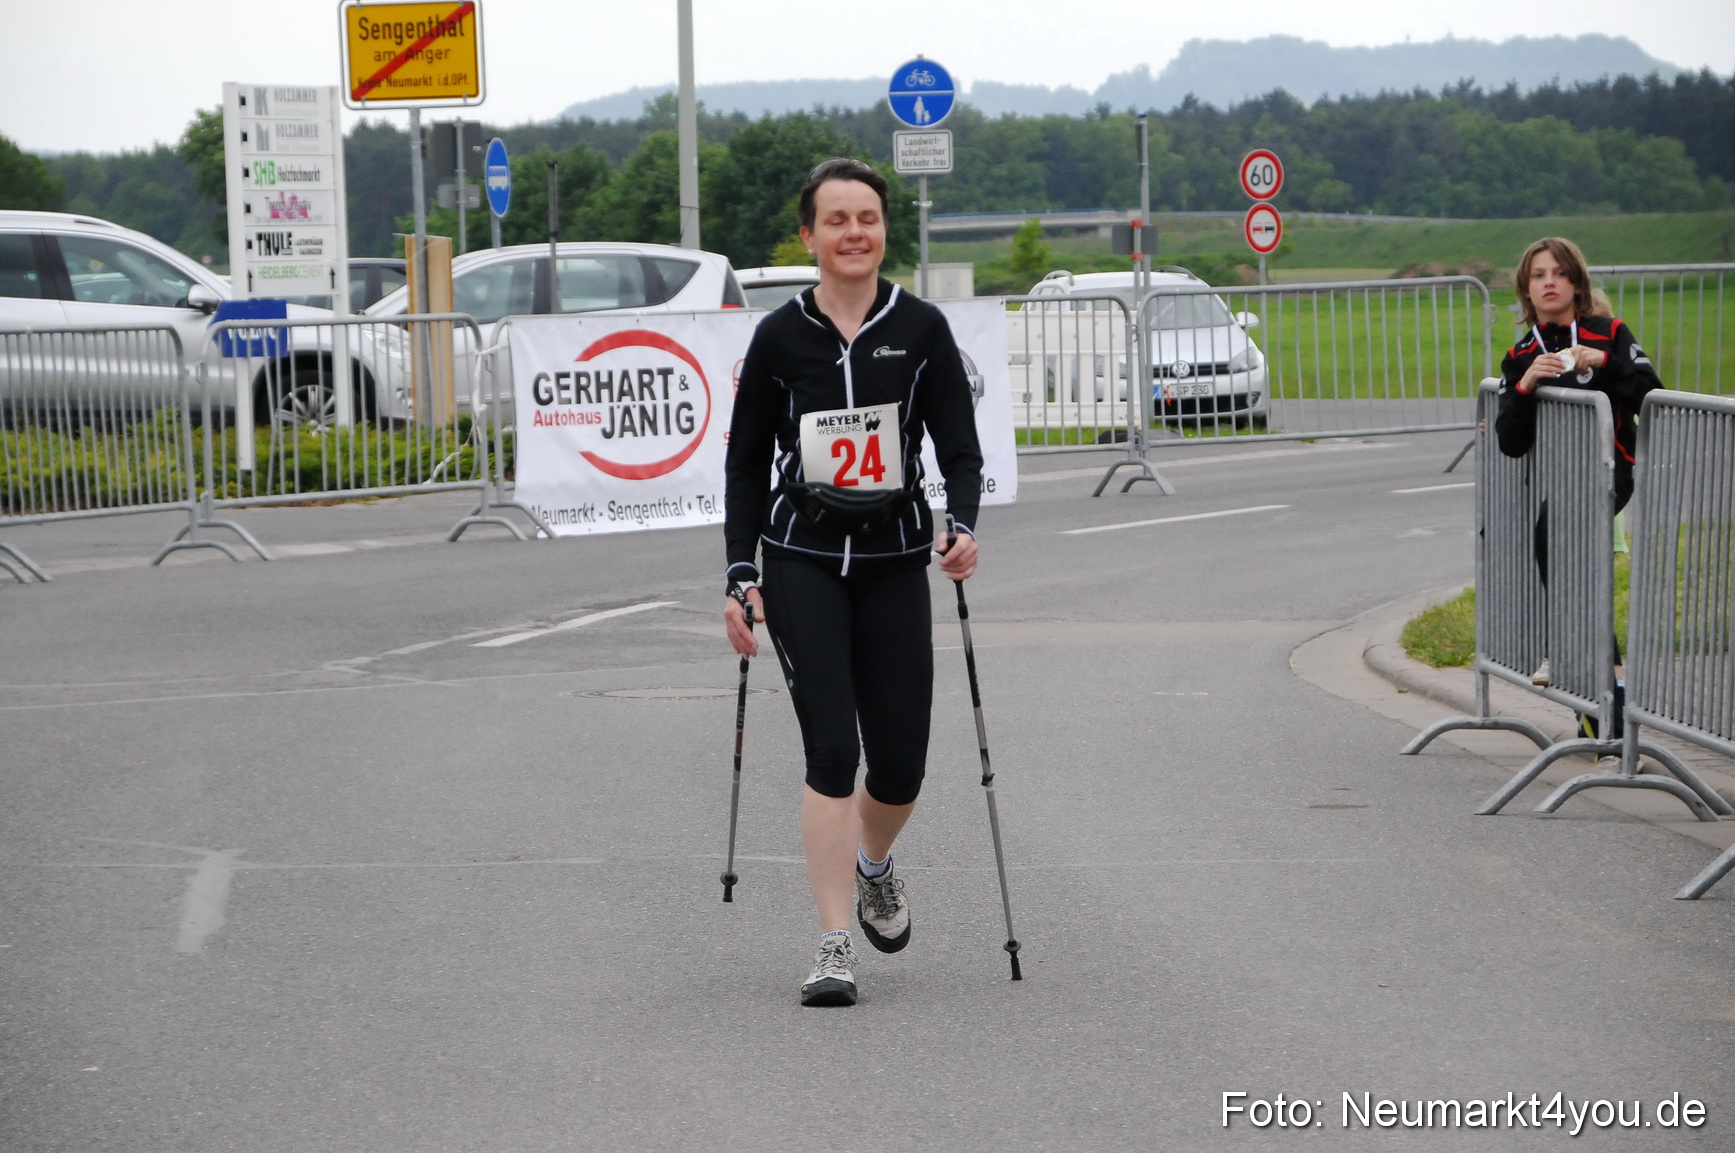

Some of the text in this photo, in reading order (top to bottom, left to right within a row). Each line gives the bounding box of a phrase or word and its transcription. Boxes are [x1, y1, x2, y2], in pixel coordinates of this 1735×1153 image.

[358, 14, 465, 46] Sengenthal
[374, 47, 451, 63] am Anger
[358, 76, 381, 88] Kreis
[386, 75, 432, 88] Neumarkt
[904, 136, 942, 146] Landwirt-
[901, 146, 946, 156] schaftlicher
[901, 158, 947, 167] Verkehr frei
[1250, 164, 1273, 186] 60
[255, 231, 293, 256] THULE
[532, 367, 690, 406] GERHART &
[533, 408, 602, 427] Autohaus
[601, 401, 695, 439] JÄNIG
[817, 414, 861, 428] MEYER
[817, 424, 862, 435] WERBUNG
[831, 434, 886, 487] 24
[531, 502, 595, 526] Neumarkt
[607, 496, 686, 524] Sengenthal
[696, 494, 722, 515] Tel.
